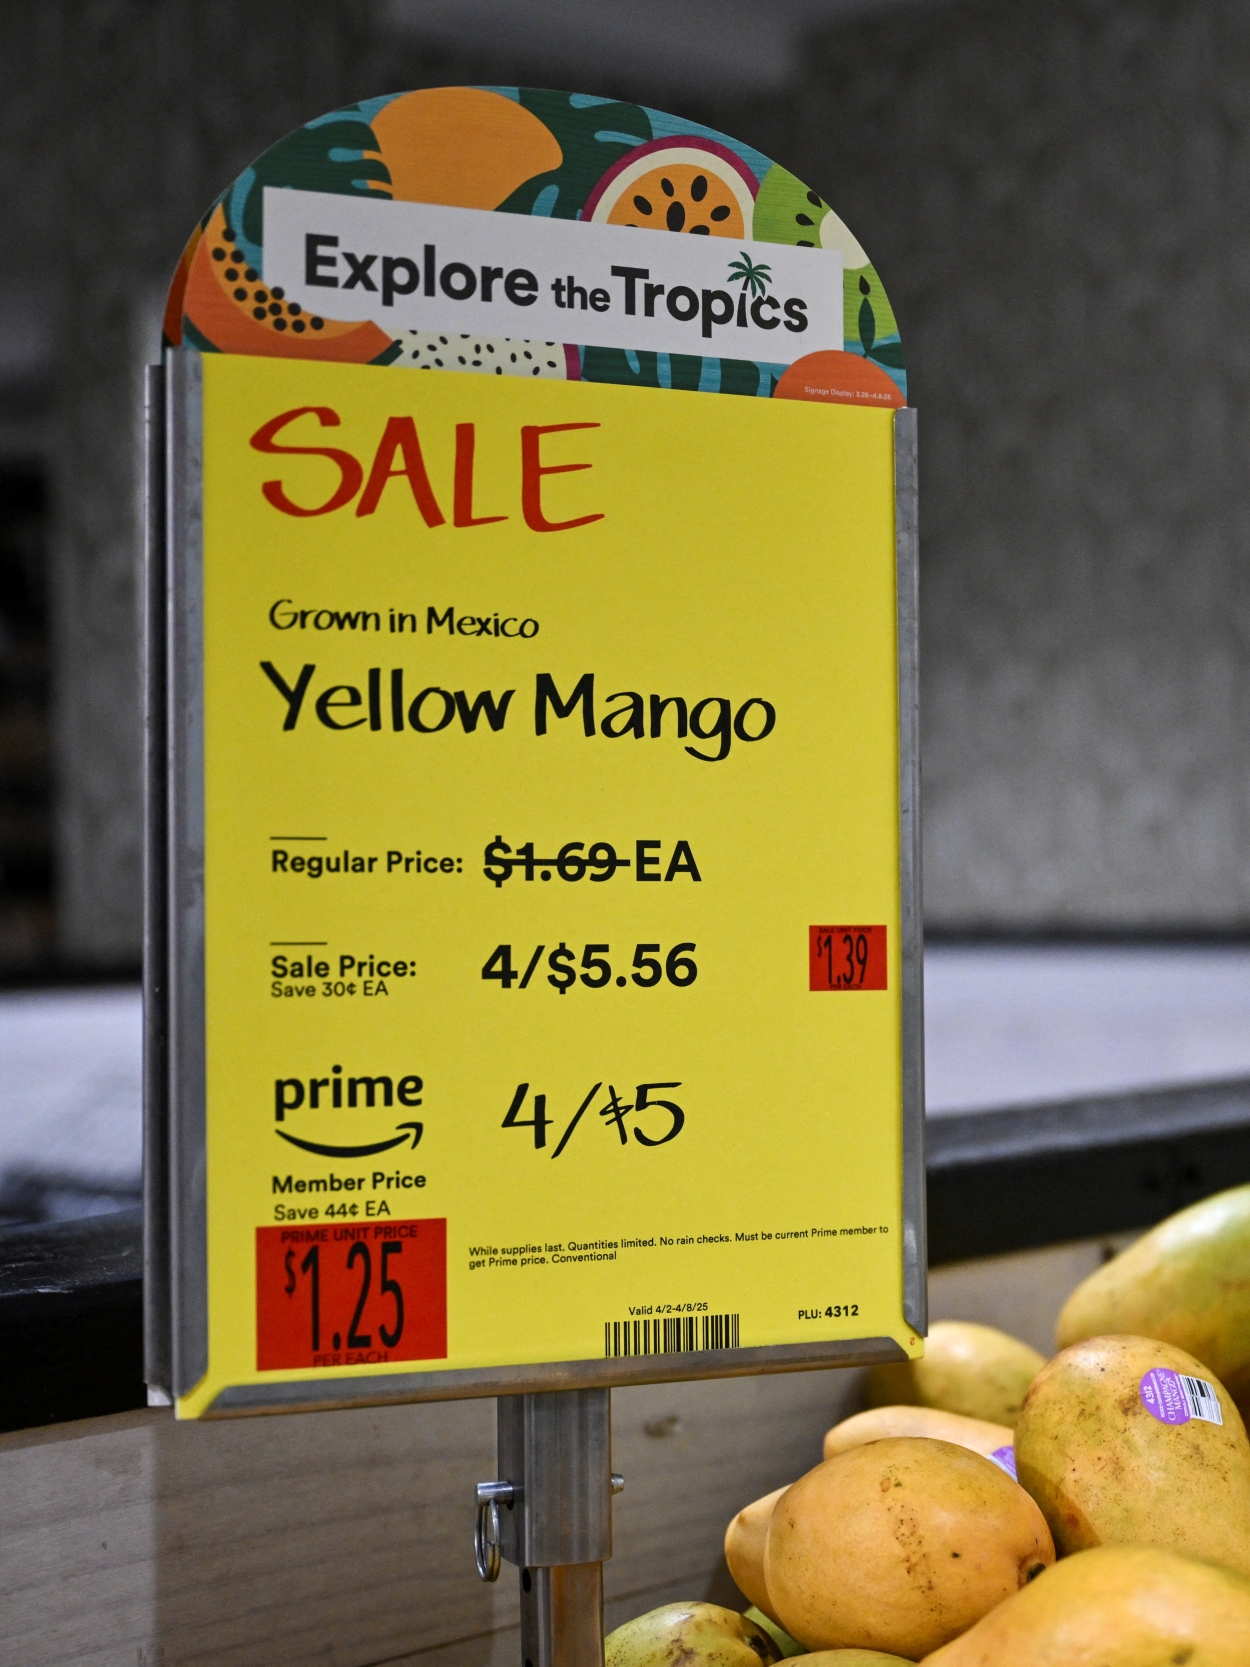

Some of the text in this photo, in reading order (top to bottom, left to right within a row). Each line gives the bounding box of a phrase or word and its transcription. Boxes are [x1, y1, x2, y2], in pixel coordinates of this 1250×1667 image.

[303, 233, 809, 338] Explore the Tropics
[804, 386, 829, 395] Signage
[830, 388, 855, 398] Display:
[250, 407, 604, 532] SALE
[269, 600, 539, 638] Grown in Mexico
[260, 661, 775, 762] Yellow Mango
[272, 850, 462, 878] Regular Price:
[484, 836, 701, 887] $1.69 EA
[272, 955, 415, 978] Sale Price:
[482, 943, 697, 994] 4/$5.56
[817, 934, 868, 984] $1.39
[272, 981, 388, 997] Save 30¢ EA
[275, 1065, 423, 1121] prime
[502, 1082, 684, 1159] 4/$5
[273, 1171, 426, 1193] Member Price
[275, 1201, 390, 1220] Save 44¢ EA
[281, 1225, 418, 1243] PRIME UNIT PRICE
[469, 1226, 889, 1256] While supplies last. Quantities limited. No rain checks. Must be current Prime member to
[469, 1251, 616, 1270] get Prime price. Conventional
[284, 1240, 404, 1352] $1.25
[629, 1302, 708, 1316] Valid 4/2-4/8/25
[798, 1305, 859, 1320] PLU: 4312
[313, 1351, 388, 1366] PER EACH
[1143, 1385, 1155, 1404] 4312
